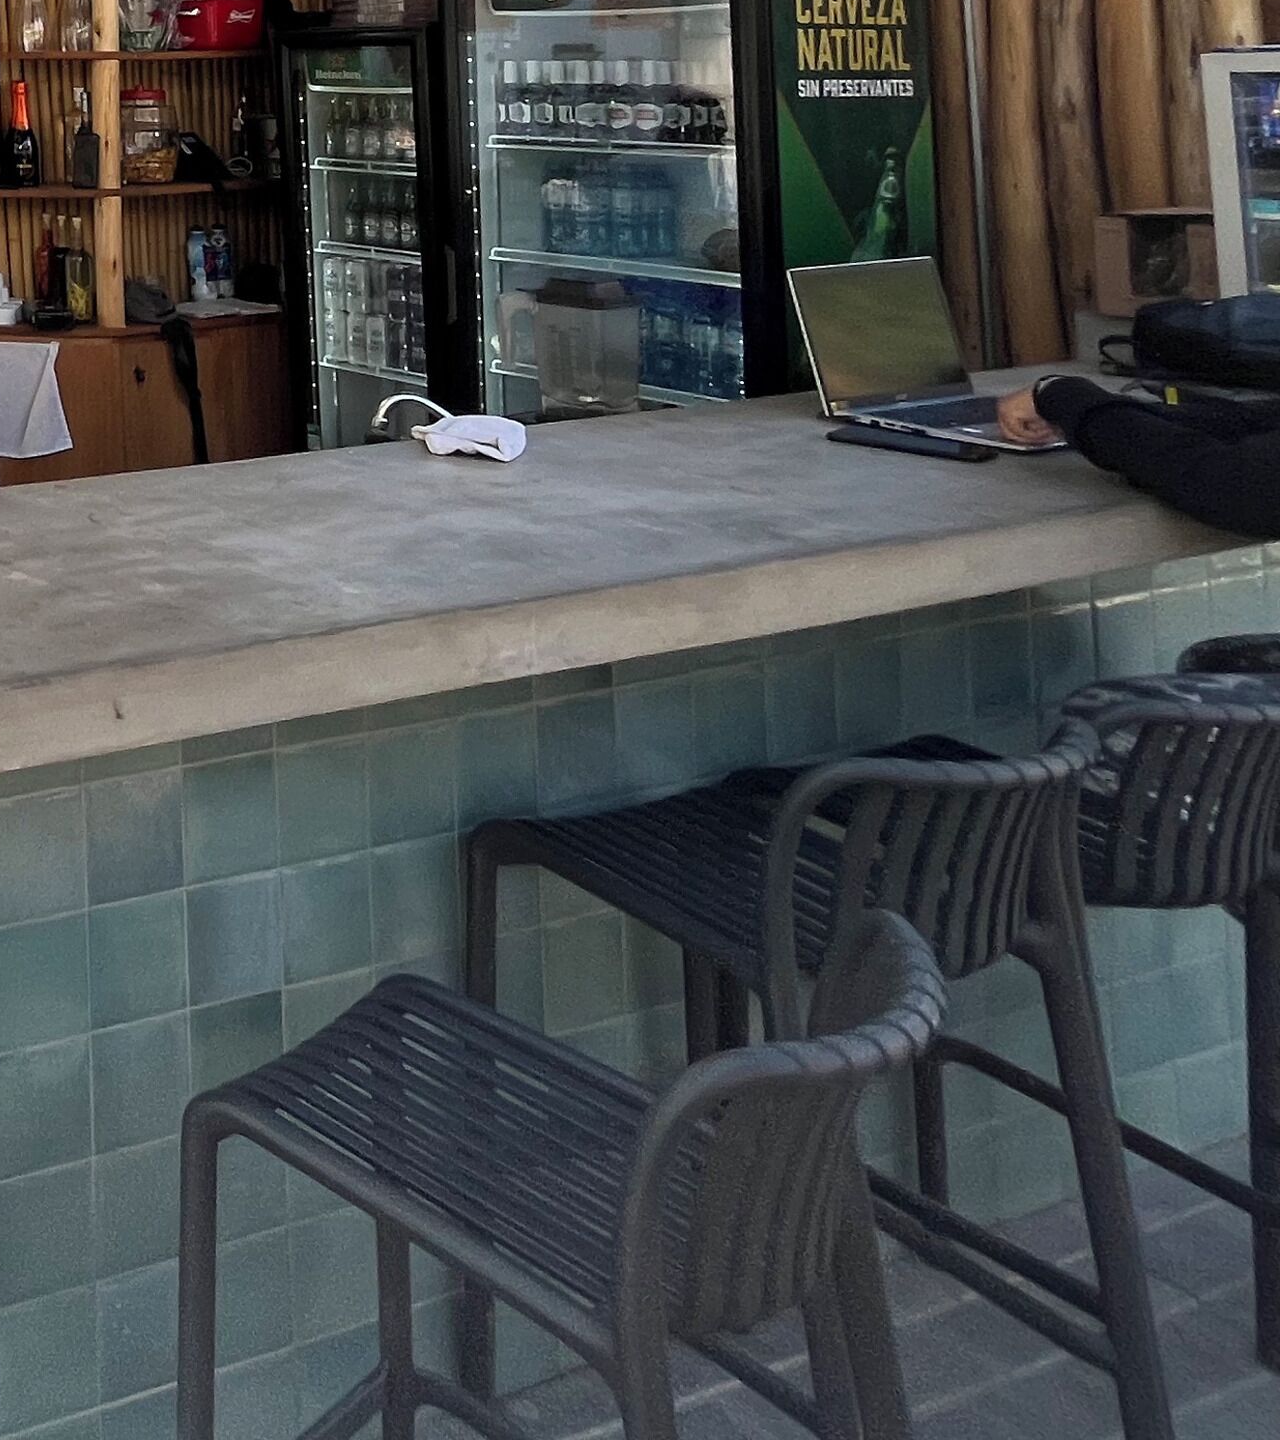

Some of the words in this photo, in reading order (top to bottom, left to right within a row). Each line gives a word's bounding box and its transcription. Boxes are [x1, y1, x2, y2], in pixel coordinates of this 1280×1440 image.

[797, 28, 912, 71] NATURAL
[797, 79, 820, 98] SIN
[822, 79, 914, 98] PRESERVANTES
